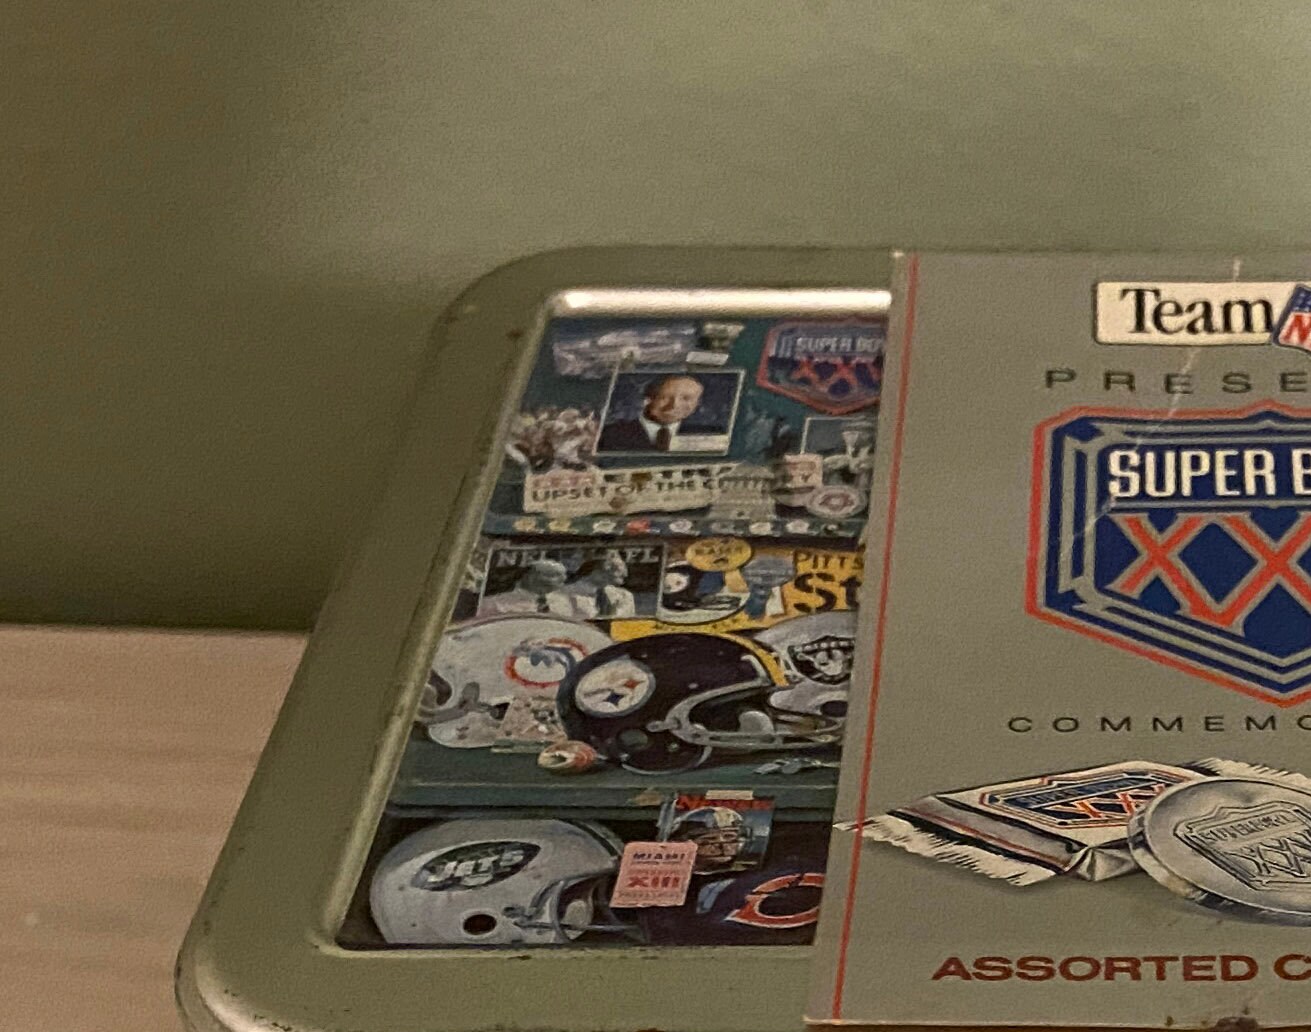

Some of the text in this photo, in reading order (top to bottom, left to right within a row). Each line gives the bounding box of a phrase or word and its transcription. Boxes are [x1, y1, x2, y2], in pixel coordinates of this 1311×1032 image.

[1120, 288, 1274, 335] Team
[1108, 449, 1277, 498] SUPER
[930, 954, 1260, 984] ASSORTED
